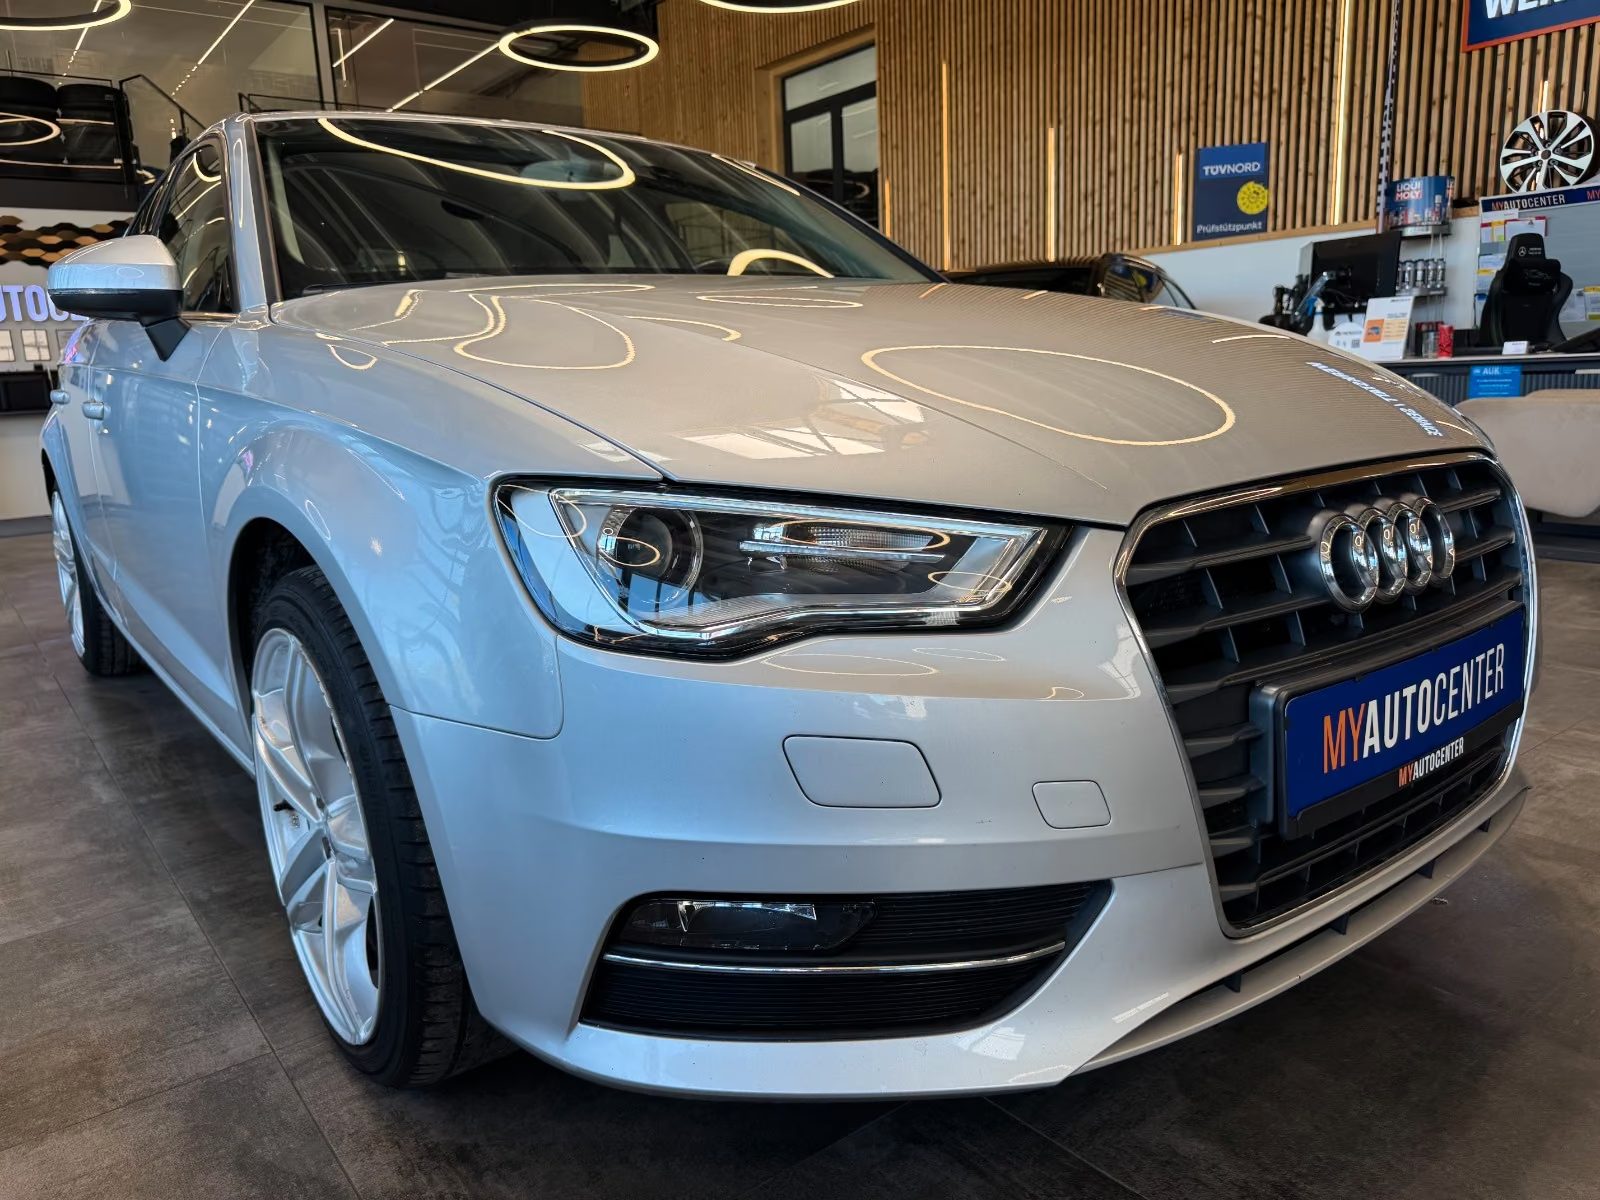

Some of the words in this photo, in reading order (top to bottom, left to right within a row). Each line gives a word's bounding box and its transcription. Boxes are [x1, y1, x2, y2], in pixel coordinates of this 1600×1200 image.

[1491, 194, 1566, 212] MYAUTOCENTER
[1196, 221, 1262, 234] Prüfstützpunkt
[1323, 643, 1505, 774] MYAUTOCENTER
[1398, 736, 1464, 788] MYAUTOCENTER
